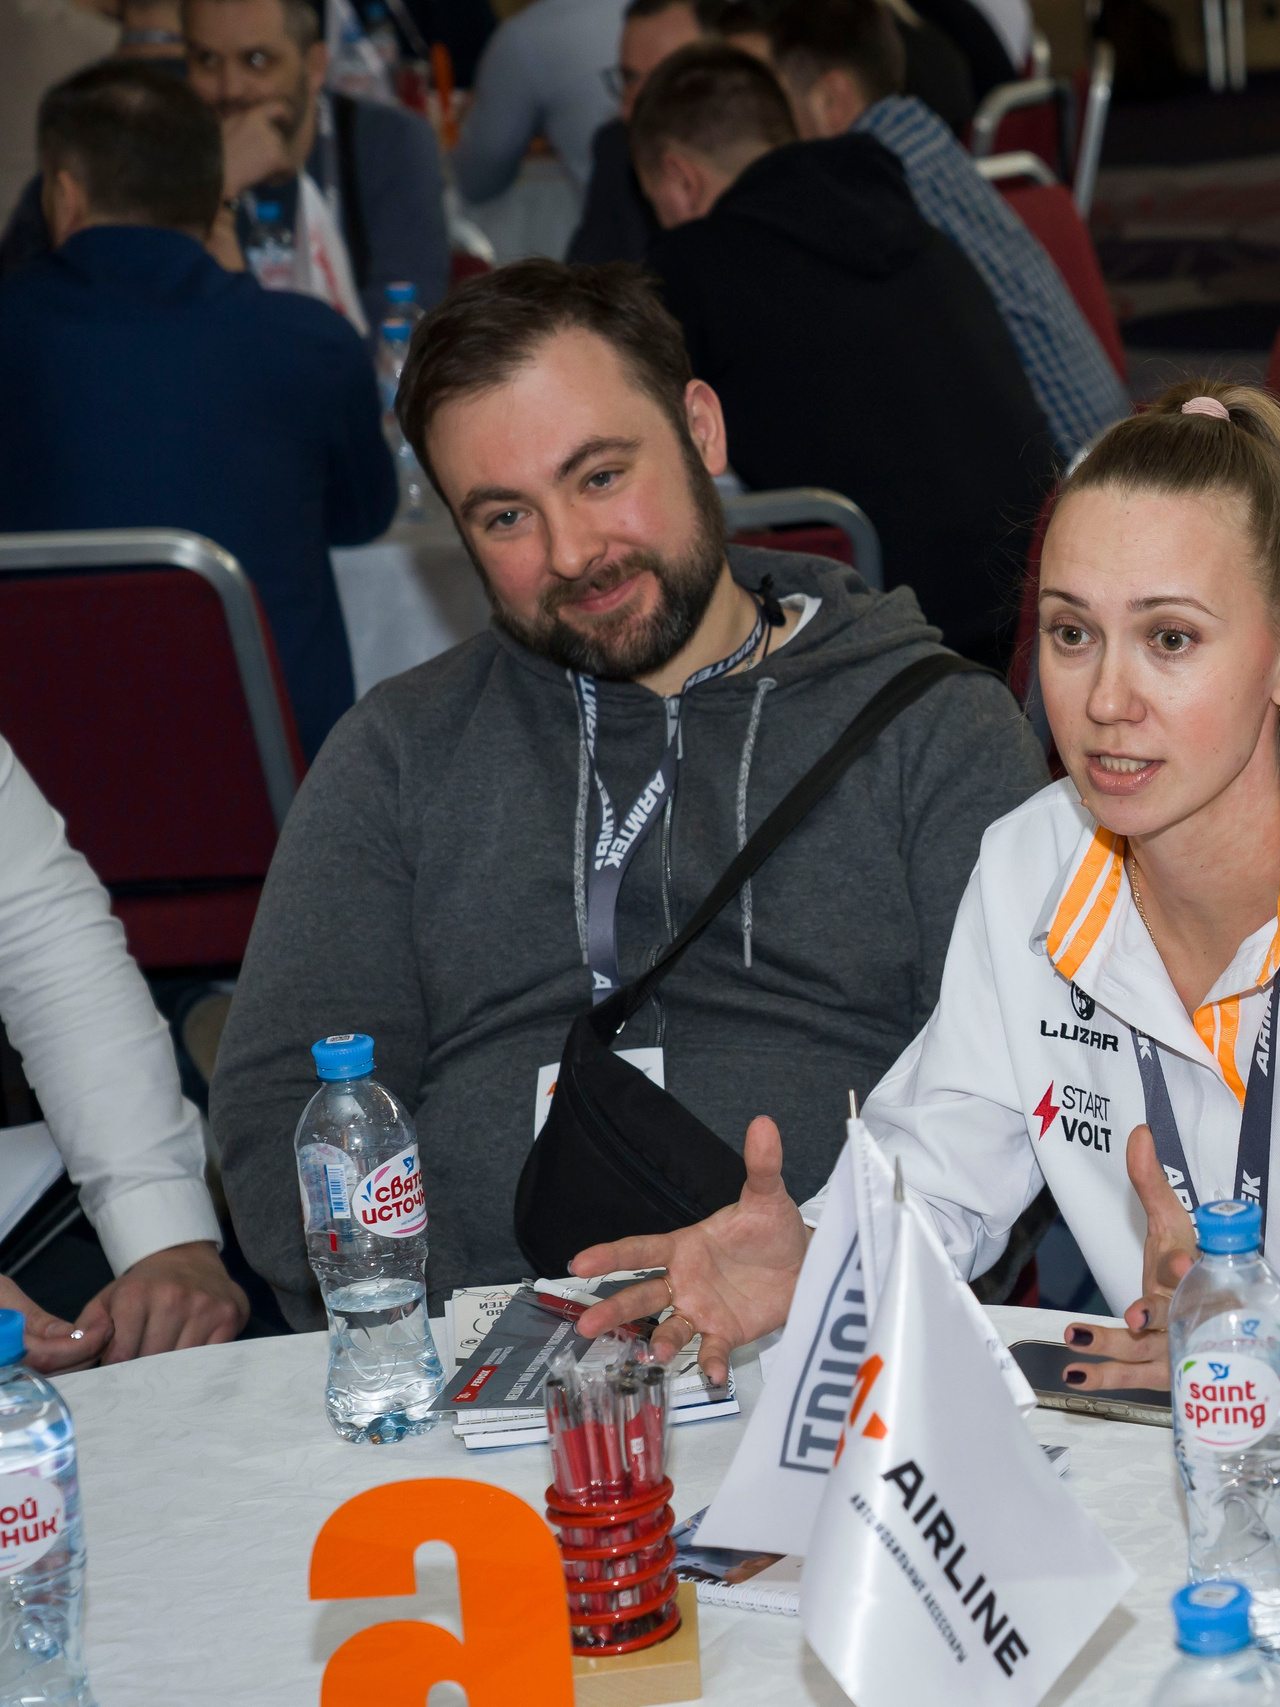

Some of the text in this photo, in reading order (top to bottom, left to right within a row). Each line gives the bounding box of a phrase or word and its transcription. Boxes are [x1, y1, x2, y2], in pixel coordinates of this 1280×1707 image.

[579, 672, 597, 760] ARMT
[604, 770, 666, 869] ARMTEK
[1040, 1020, 1119, 1052] LUZAR
[1062, 1085, 1110, 1121] START
[1061, 1115, 1111, 1153] VOLT
[1189, 1380, 1256, 1402] saint
[1184, 1402, 1266, 1429] spring
[881, 1460, 1030, 1679] AIRLINE
